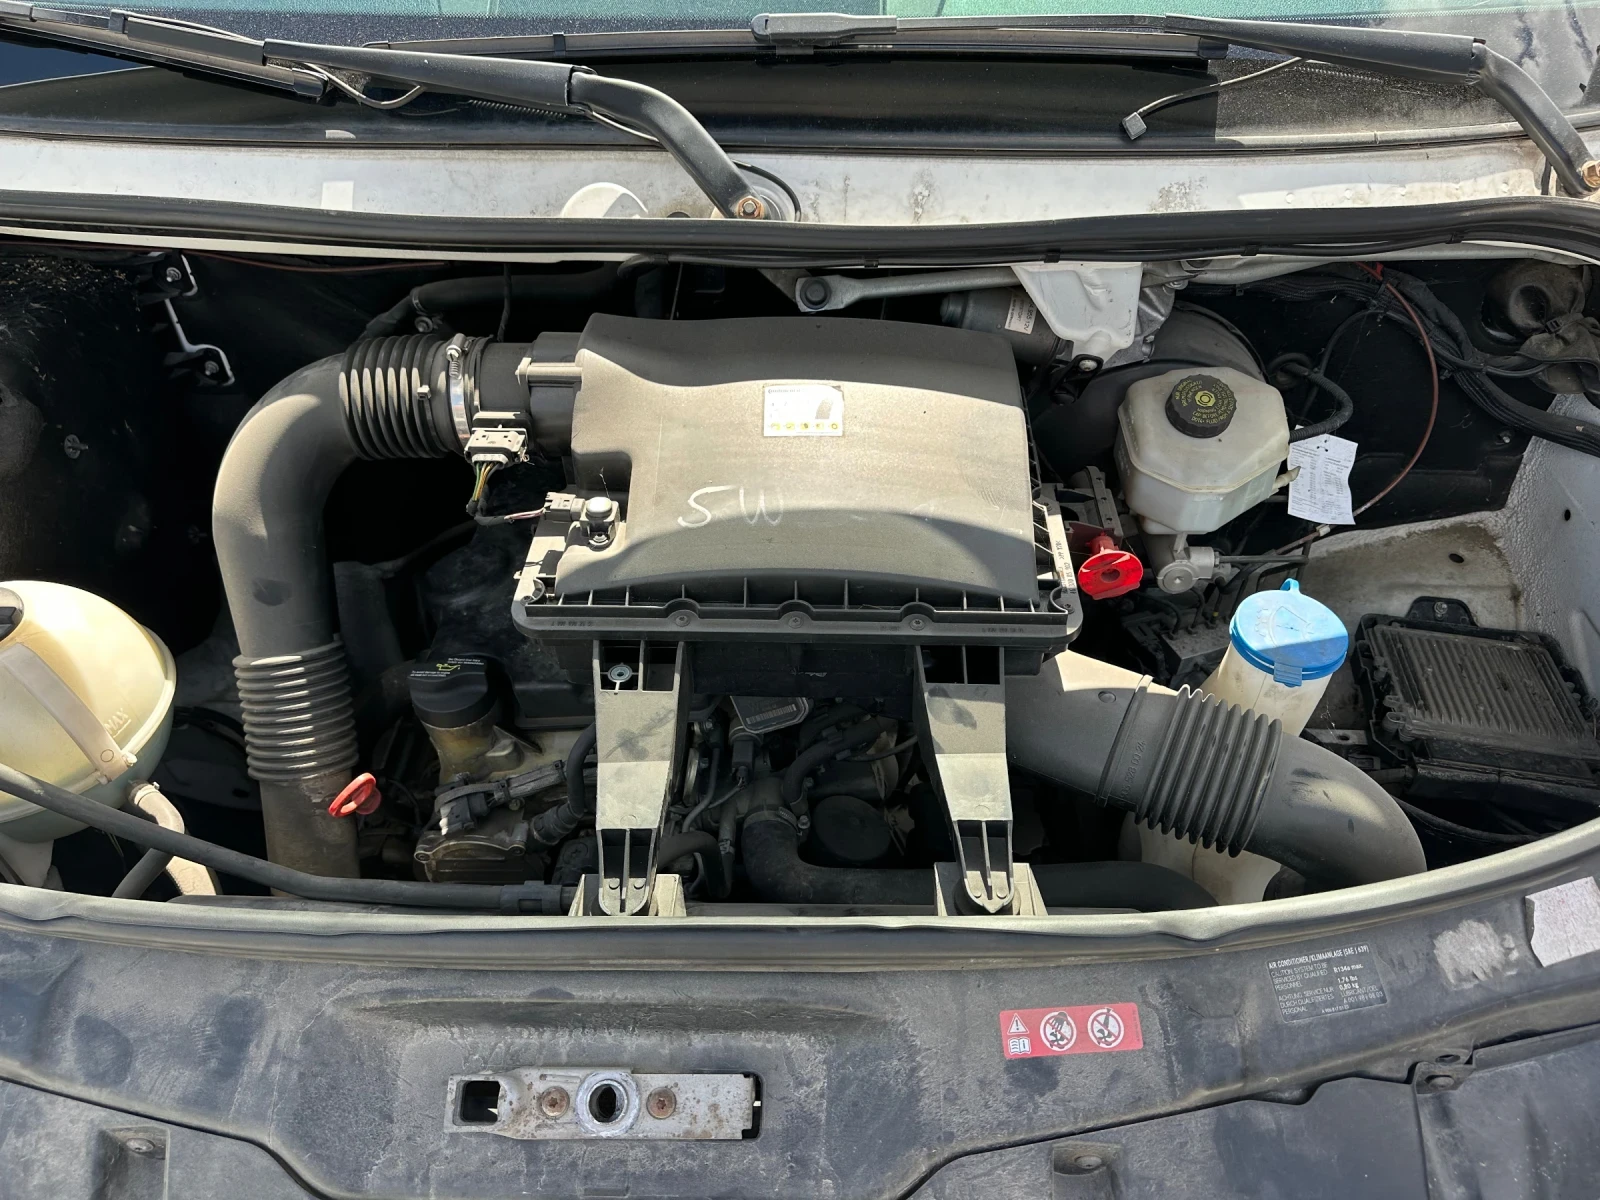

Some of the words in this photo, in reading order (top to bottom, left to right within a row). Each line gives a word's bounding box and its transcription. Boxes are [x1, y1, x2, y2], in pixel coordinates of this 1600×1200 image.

[1273, 974, 1296, 985] SERVICED
[1296, 972, 1303, 981] BY
[1275, 981, 1303, 991] PERSONNEL
